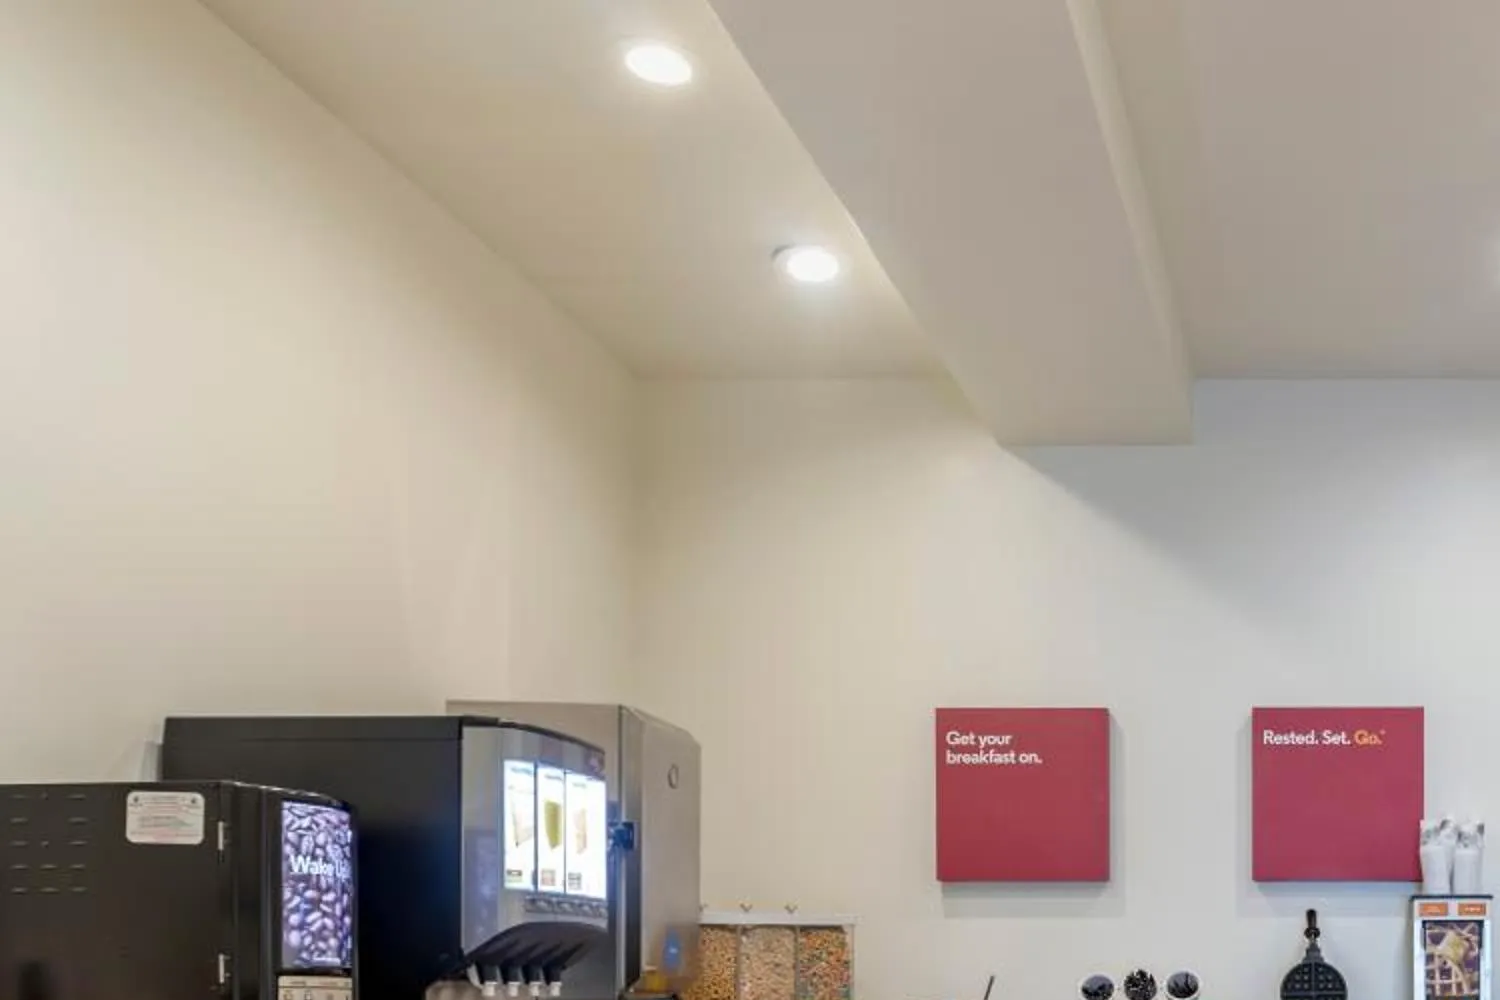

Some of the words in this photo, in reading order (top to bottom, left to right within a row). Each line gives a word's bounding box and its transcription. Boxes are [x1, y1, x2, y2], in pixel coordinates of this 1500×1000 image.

[946, 730, 977, 745] Get
[978, 735, 1012, 749] your
[1263, 729, 1319, 745] Rested.
[1322, 729, 1351, 745] Set.
[946, 749, 1017, 764] breakfast
[1019, 752, 1043, 764] on.
[290, 854, 334, 876] Wake
